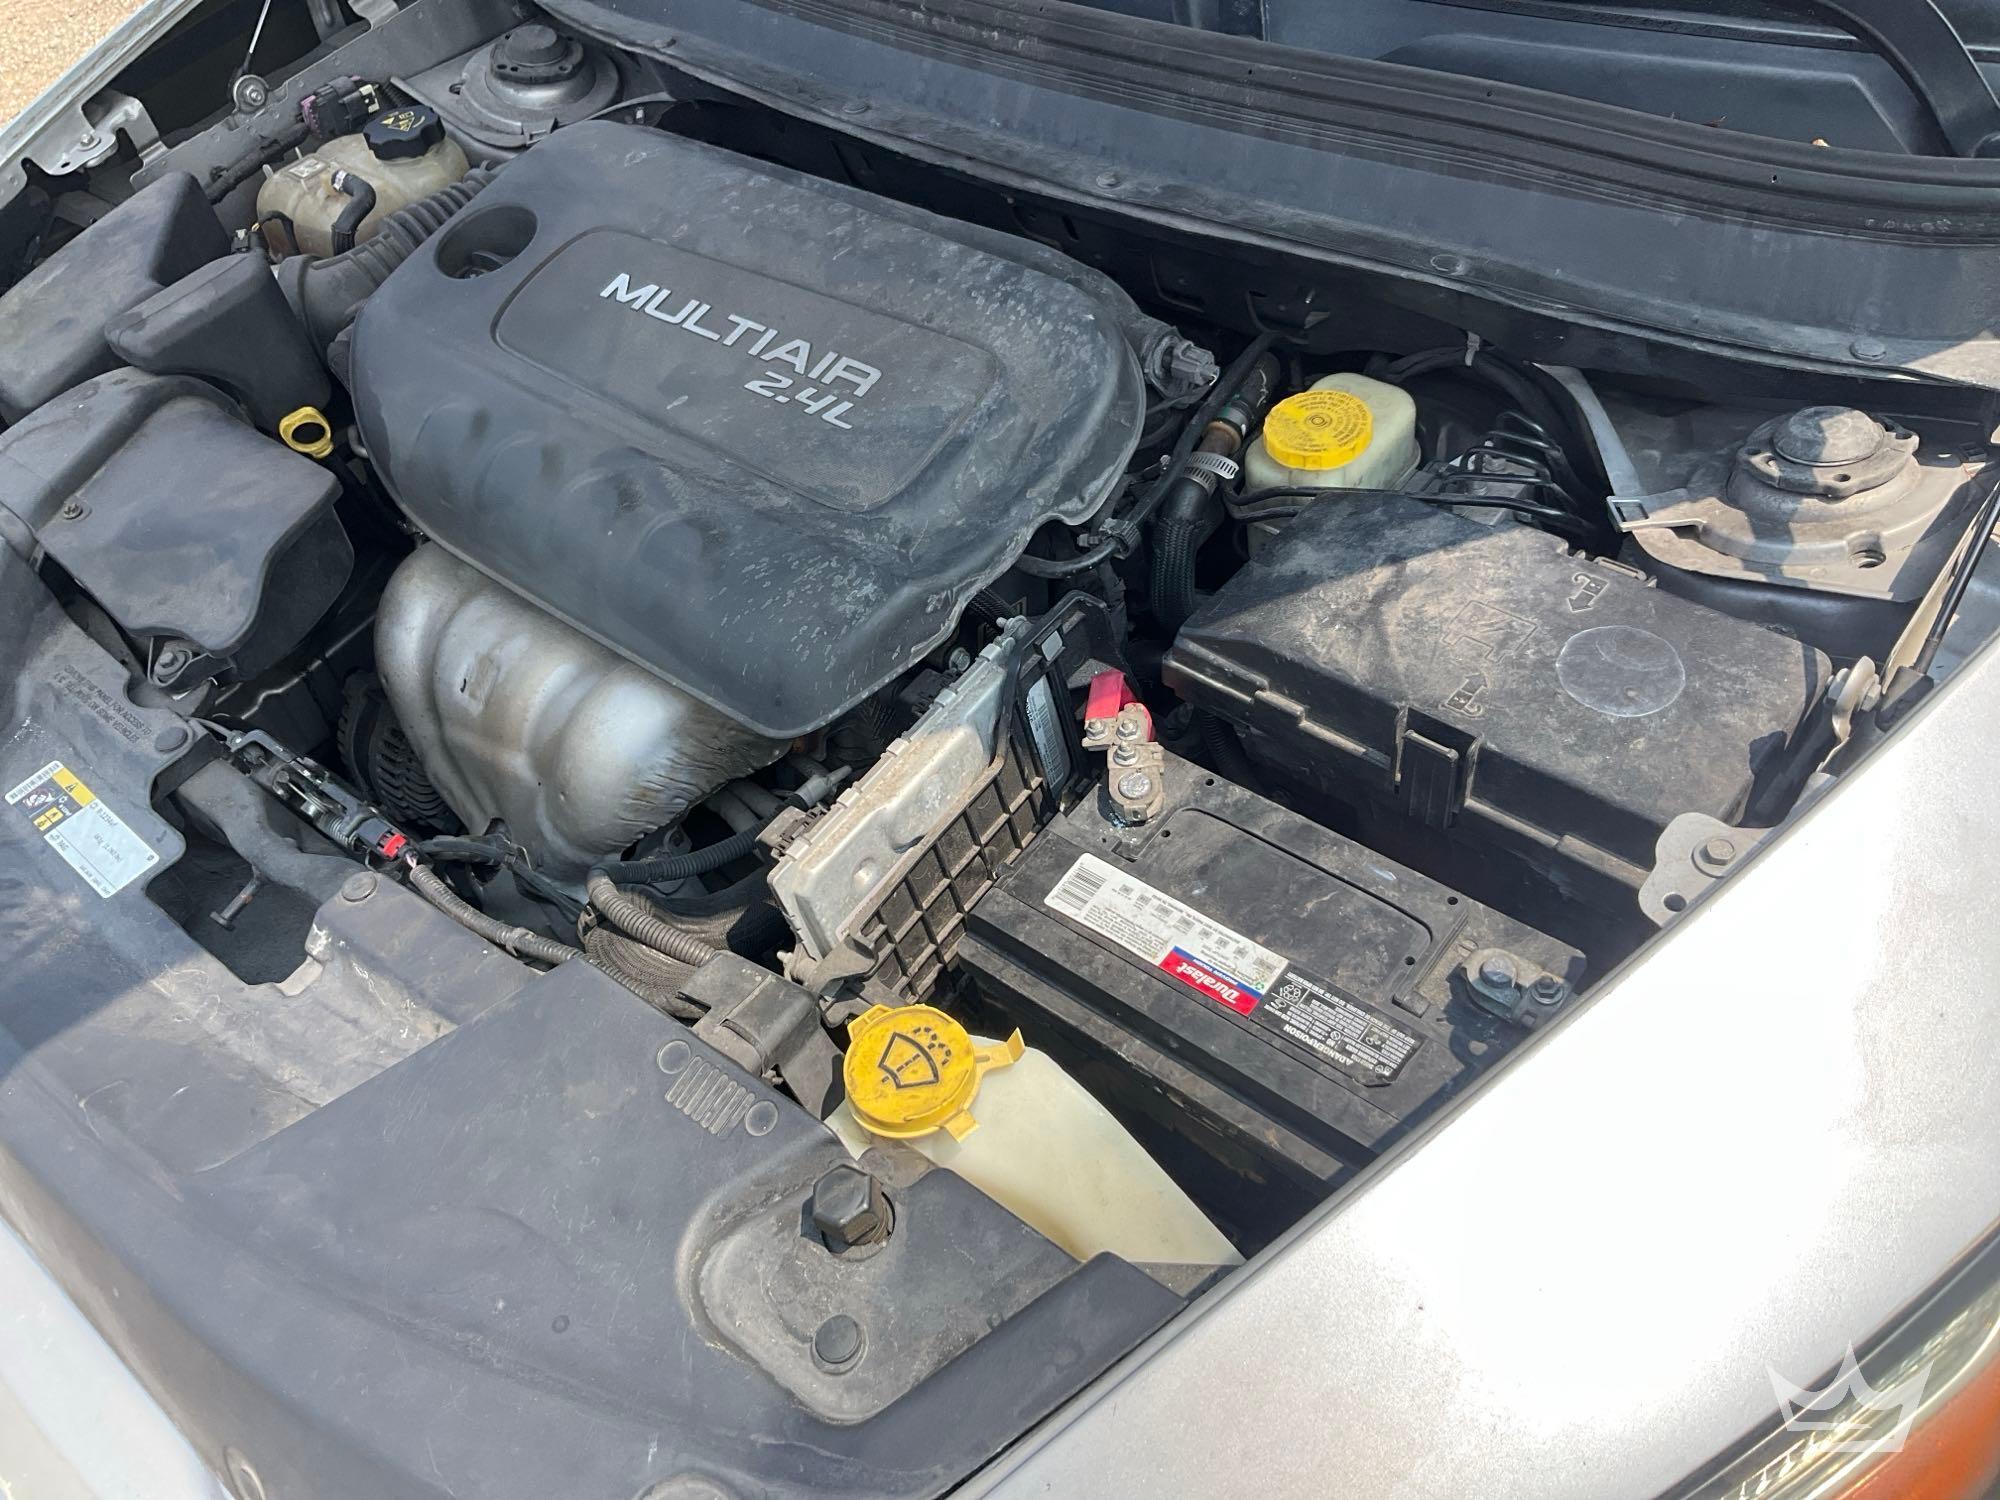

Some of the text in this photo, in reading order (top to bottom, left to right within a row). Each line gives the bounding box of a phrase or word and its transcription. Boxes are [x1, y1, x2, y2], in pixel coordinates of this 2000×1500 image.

[600, 272, 882, 398] MULTIAIR
[744, 370, 854, 429] 2.4L
[1174, 960, 1241, 1004] Duralast
